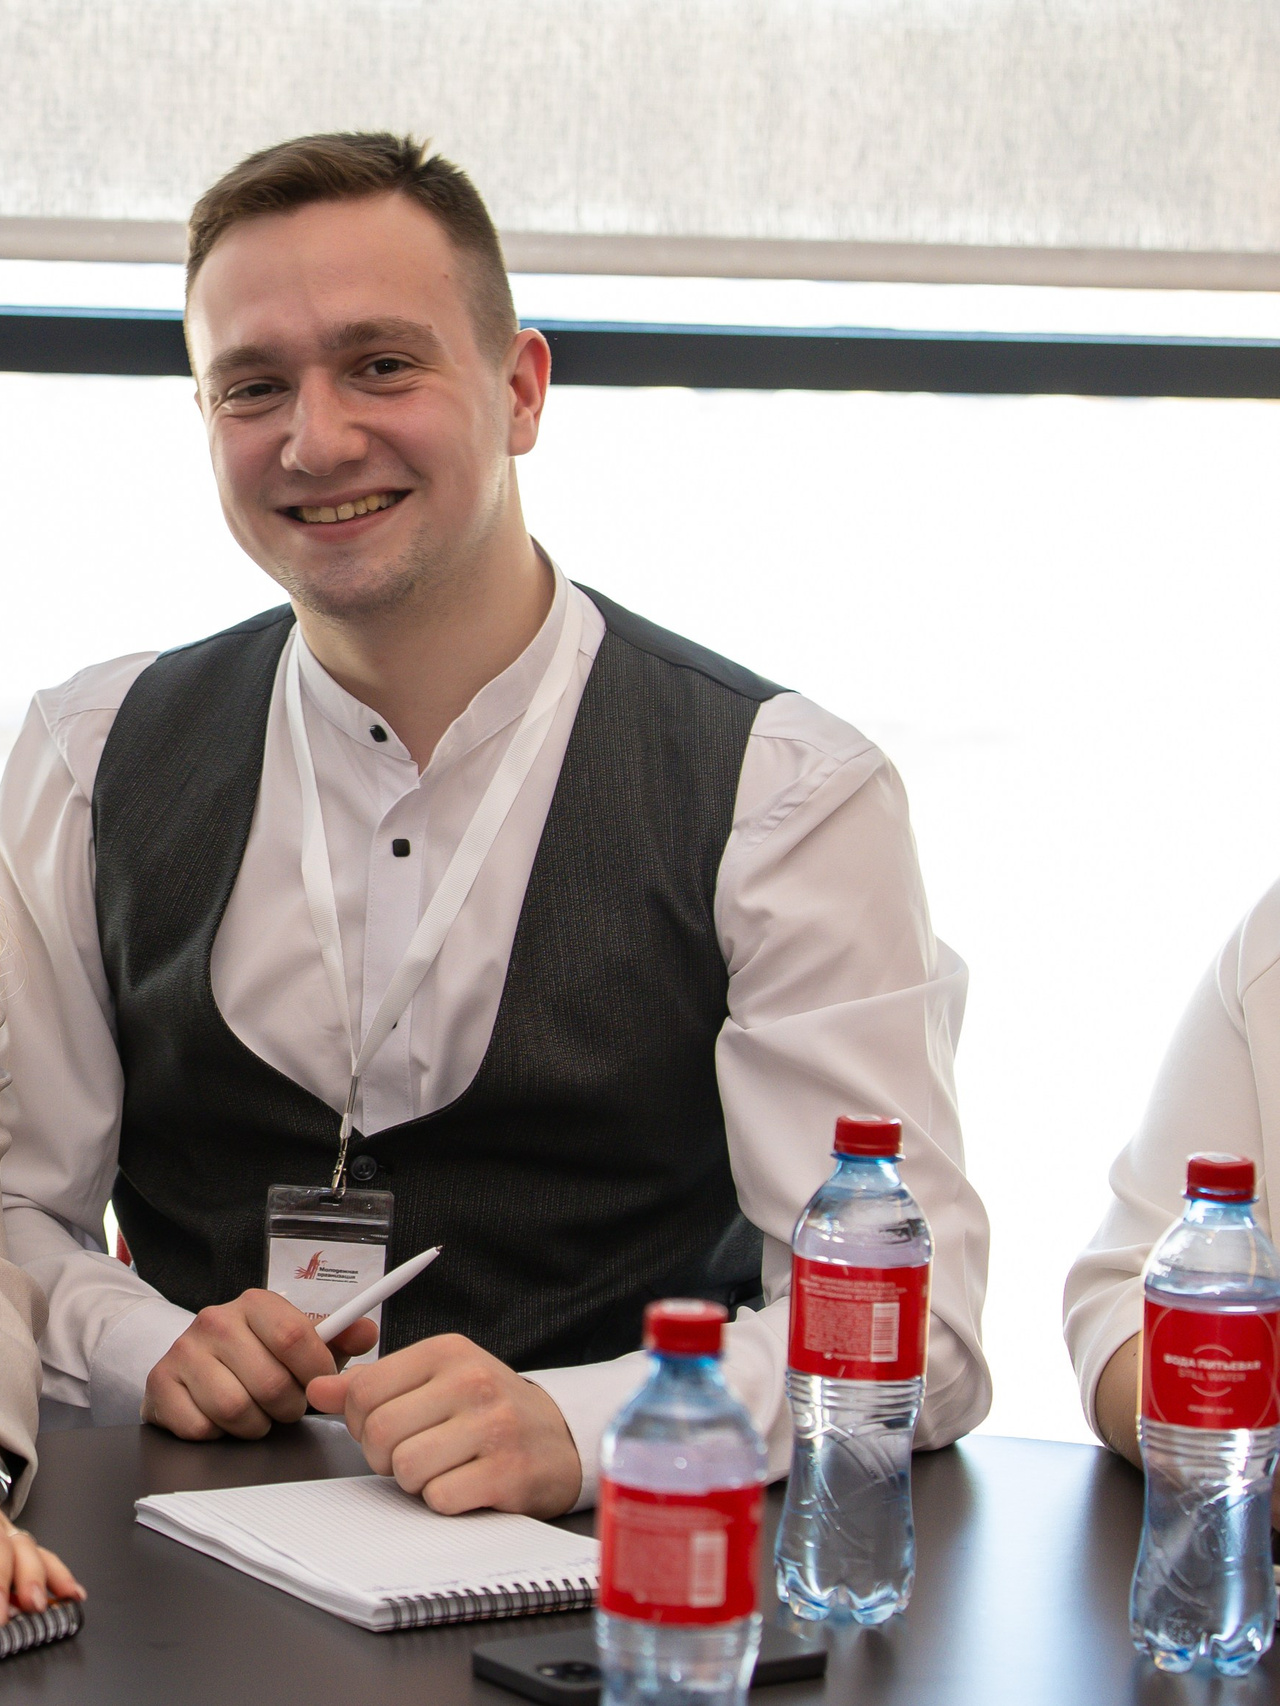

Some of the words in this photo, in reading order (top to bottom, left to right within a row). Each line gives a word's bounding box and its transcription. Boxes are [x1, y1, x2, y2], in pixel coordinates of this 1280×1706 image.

[1163, 1353, 1196, 1368] ВОДА
[1197, 1358, 1261, 1371] ПИТЬЕВАЯ
[1178, 1367, 1206, 1381] STILL
[1206, 1371, 1246, 1383] WATER
